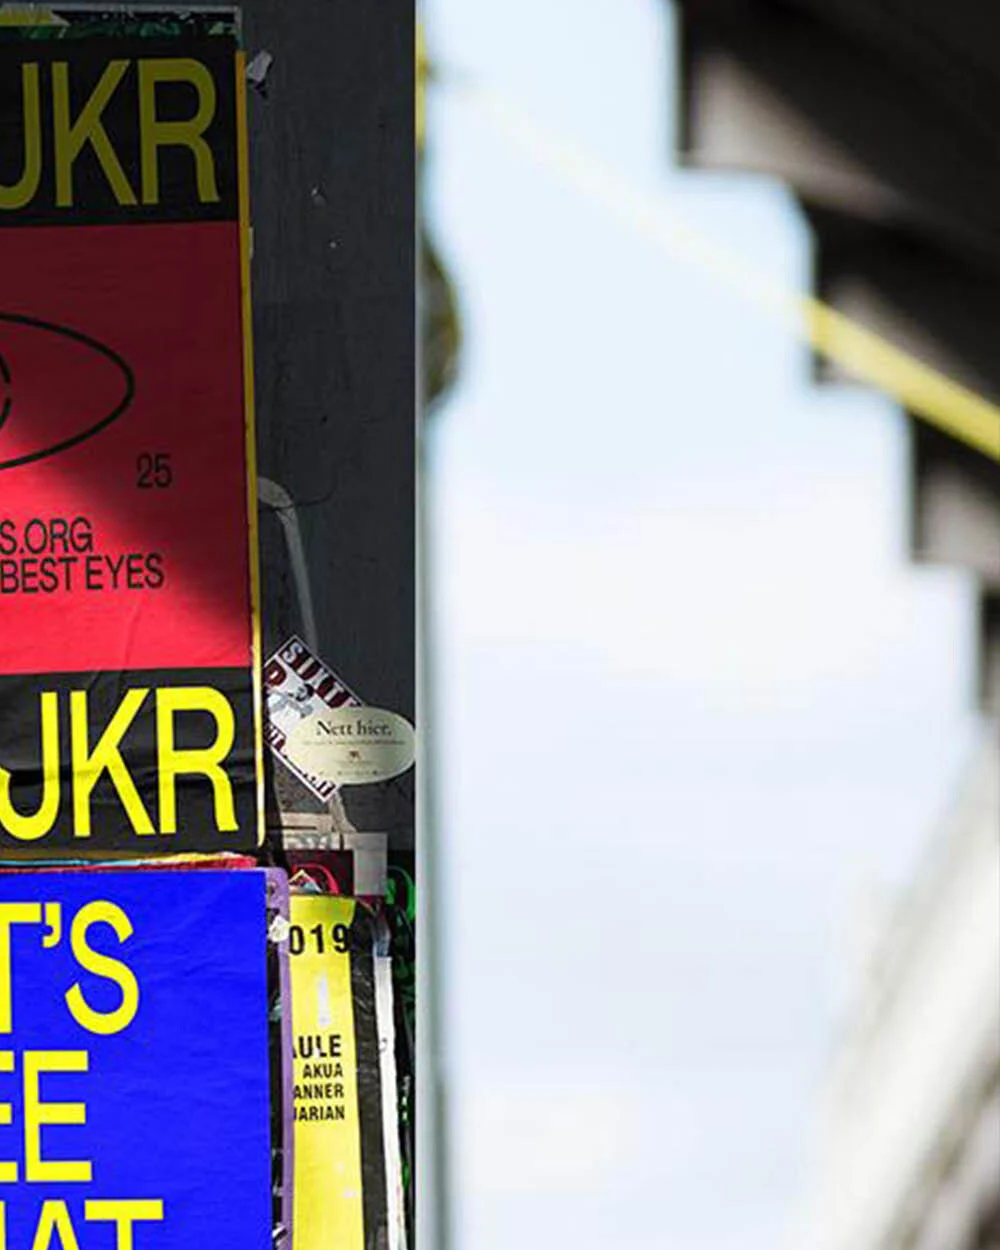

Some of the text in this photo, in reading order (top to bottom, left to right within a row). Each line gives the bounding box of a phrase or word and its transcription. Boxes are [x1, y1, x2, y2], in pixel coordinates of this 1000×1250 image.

[136, 452, 173, 488] 25
[0, 556, 78, 594] BEST
[86, 553, 164, 590] EYES
[316, 719, 393, 736] Nett hier.
[303, 1062, 343, 1079] AKUA
